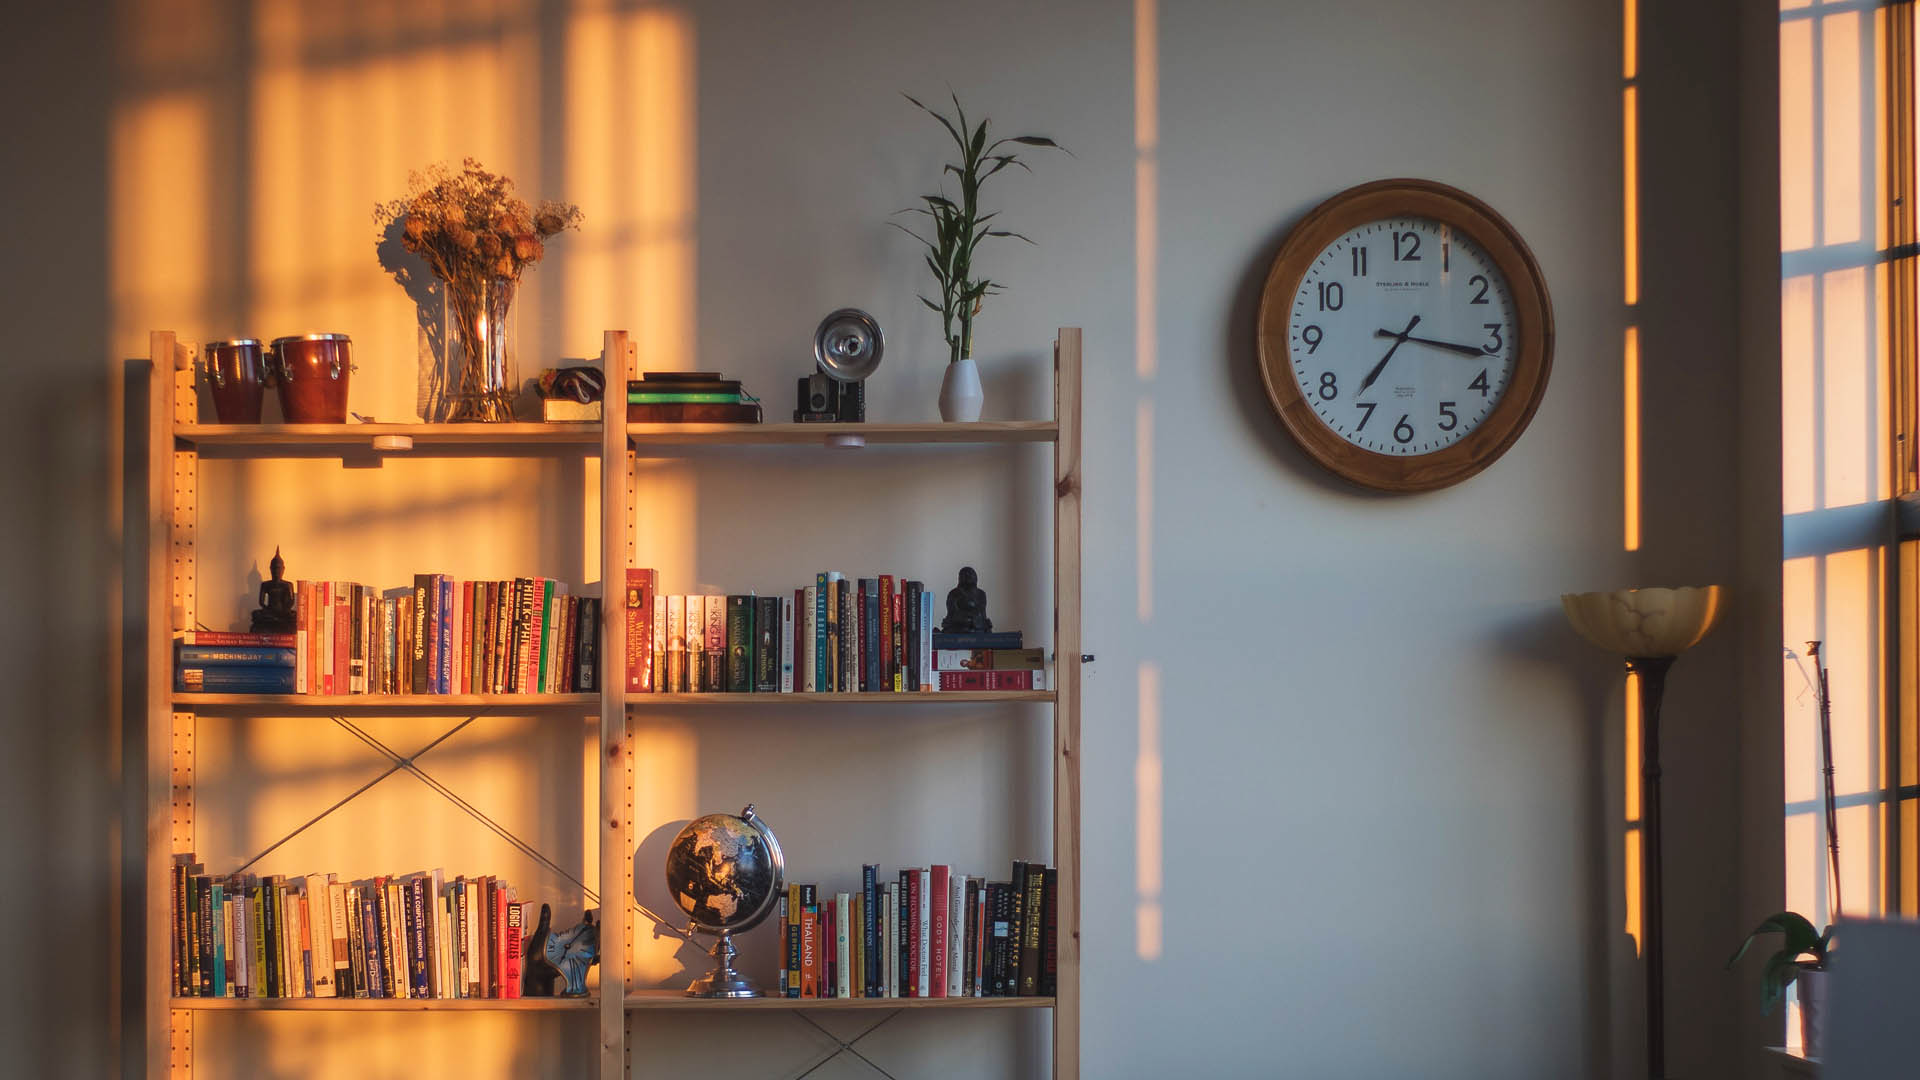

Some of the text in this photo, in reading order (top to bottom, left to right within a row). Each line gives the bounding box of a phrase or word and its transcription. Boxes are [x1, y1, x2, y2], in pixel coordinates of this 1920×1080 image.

[1393, 232, 1421, 261] 12
[1443, 244, 1448, 272] 1
[1352, 247, 1366, 276] 11
[1318, 282, 1344, 311] 10
[1469, 275, 1489, 304] 2
[1302, 325, 1323, 354] 9
[1483, 324, 1503, 353] 3
[1319, 372, 1338, 400] 8
[1467, 368, 1490, 397] 4
[1356, 403, 1377, 432] 7
[1393, 414, 1414, 444] 6
[1438, 402, 1457, 431] 5
[522, 577, 533, 616] CHUCK
[530, 580, 543, 666] CHUCK PALAHNIUK
[710, 611, 719, 634] KING
[910, 882, 916, 893] ON
[234, 896, 244, 943] Philosophy
[509, 906, 520, 959] LOGIC PUZZLES
[804, 918, 813, 966] THAILAND
[1012, 921, 1022, 967] PHYSICS
